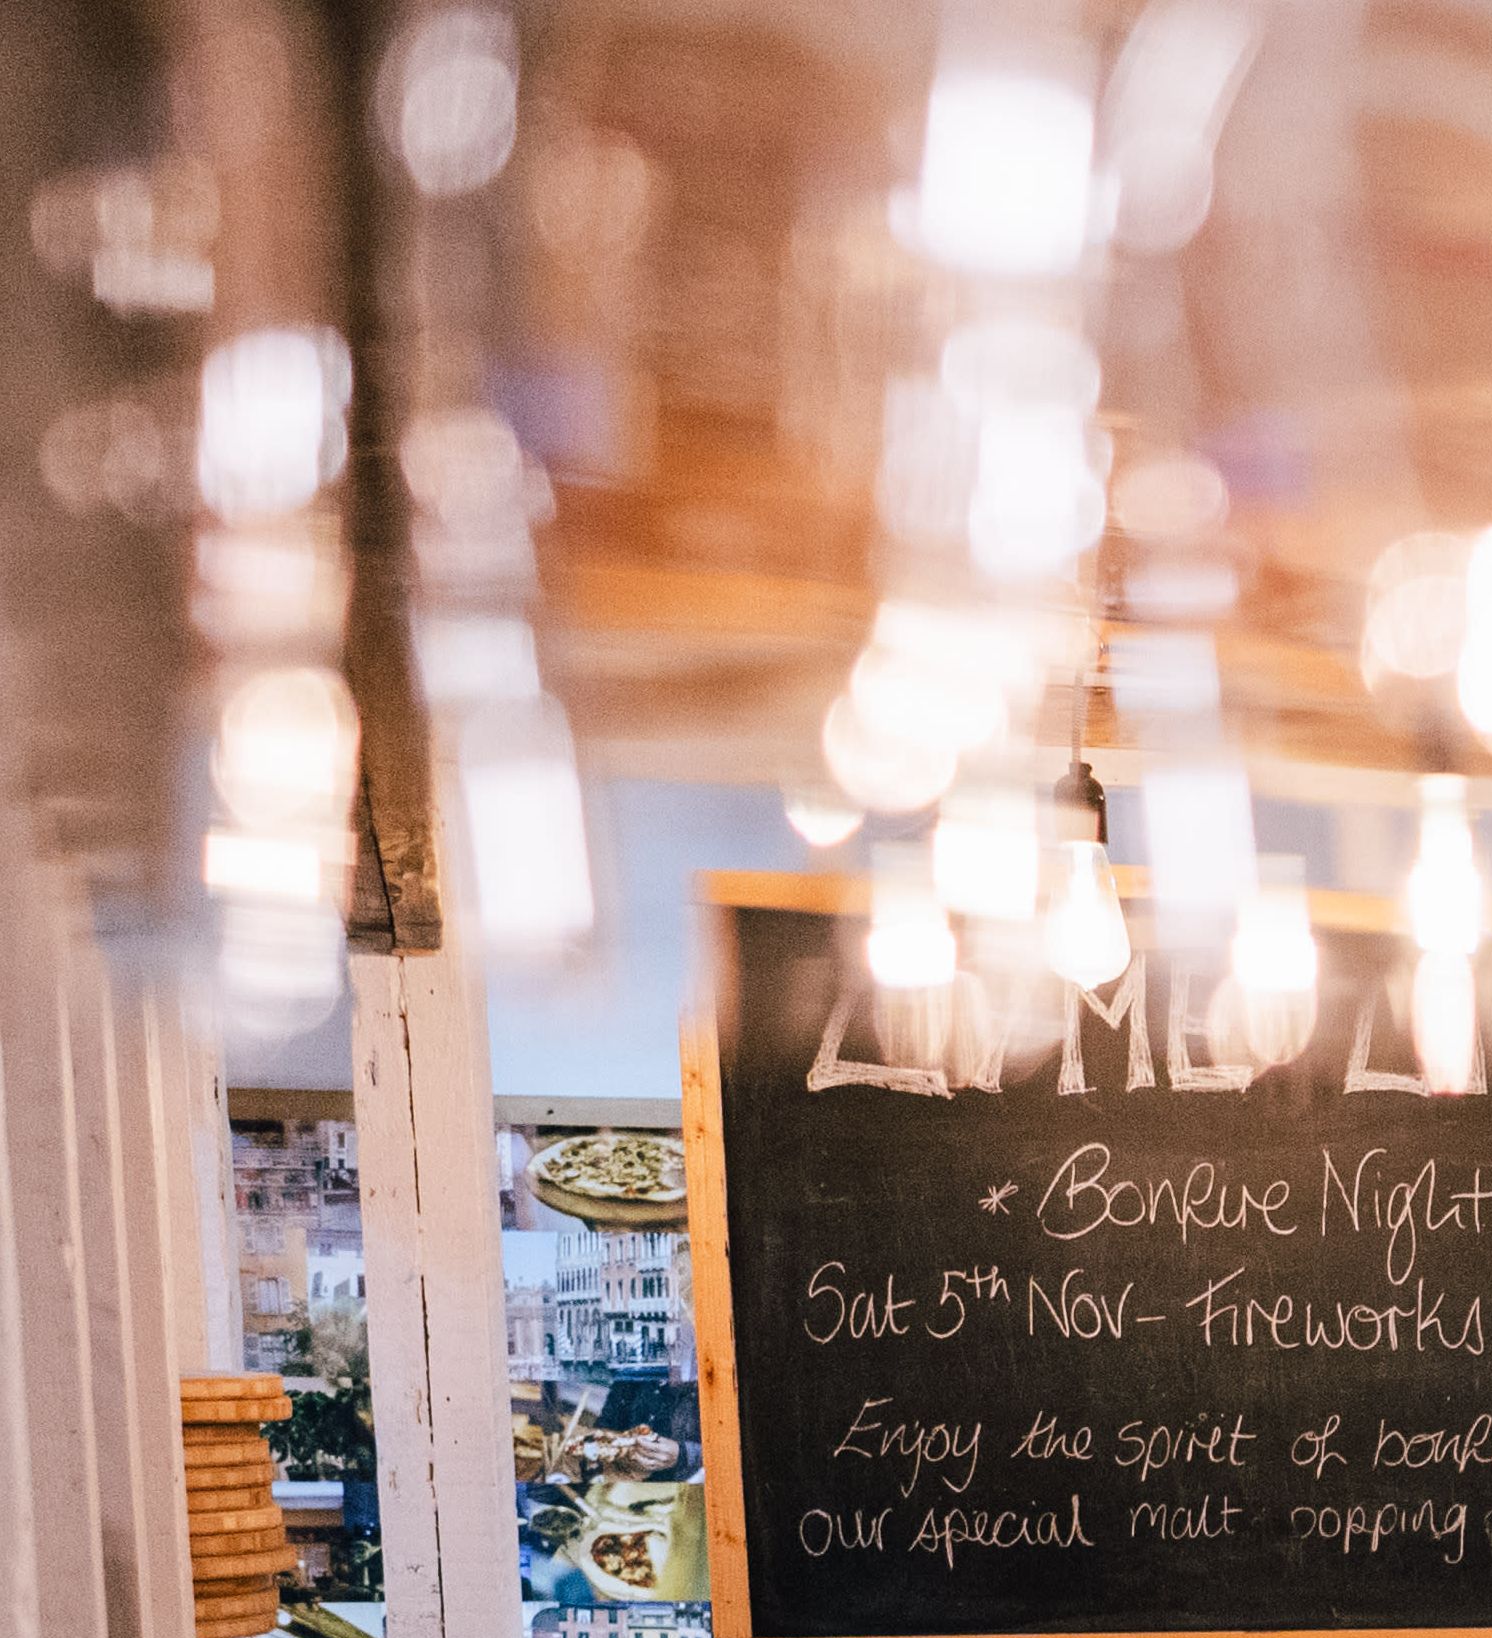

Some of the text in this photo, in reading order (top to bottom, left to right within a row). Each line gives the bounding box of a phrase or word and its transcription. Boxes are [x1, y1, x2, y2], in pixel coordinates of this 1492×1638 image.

[1037, 1142, 1298, 1244] Bonfire
[804, 1261, 917, 1344] Sat
[925, 1265, 1011, 1339] 5th
[1186, 1267, 1485, 1356] Fireworks
[833, 1397, 983, 1498] Enjoy
[1010, 1410, 1095, 1460] the
[1291, 1413, 1348, 1479] of
[800, 1508, 894, 1557] our
[908, 1494, 1095, 1571] special
[1131, 1495, 1243, 1541] malt
